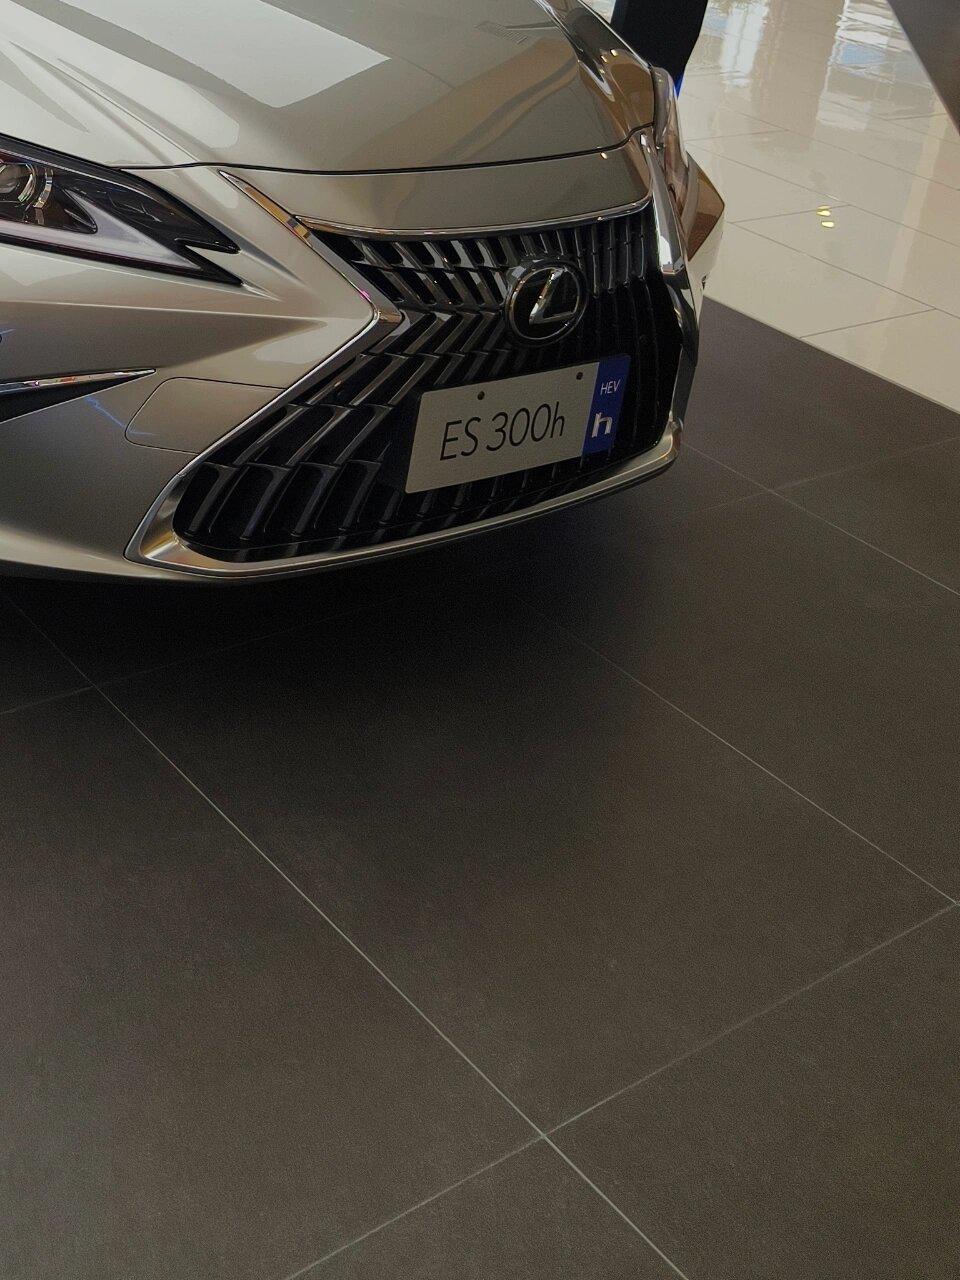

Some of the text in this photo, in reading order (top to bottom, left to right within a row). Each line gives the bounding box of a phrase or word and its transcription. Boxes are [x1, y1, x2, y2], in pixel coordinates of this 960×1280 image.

[600, 378, 620, 395] HEV
[440, 401, 566, 461] ES 300h
